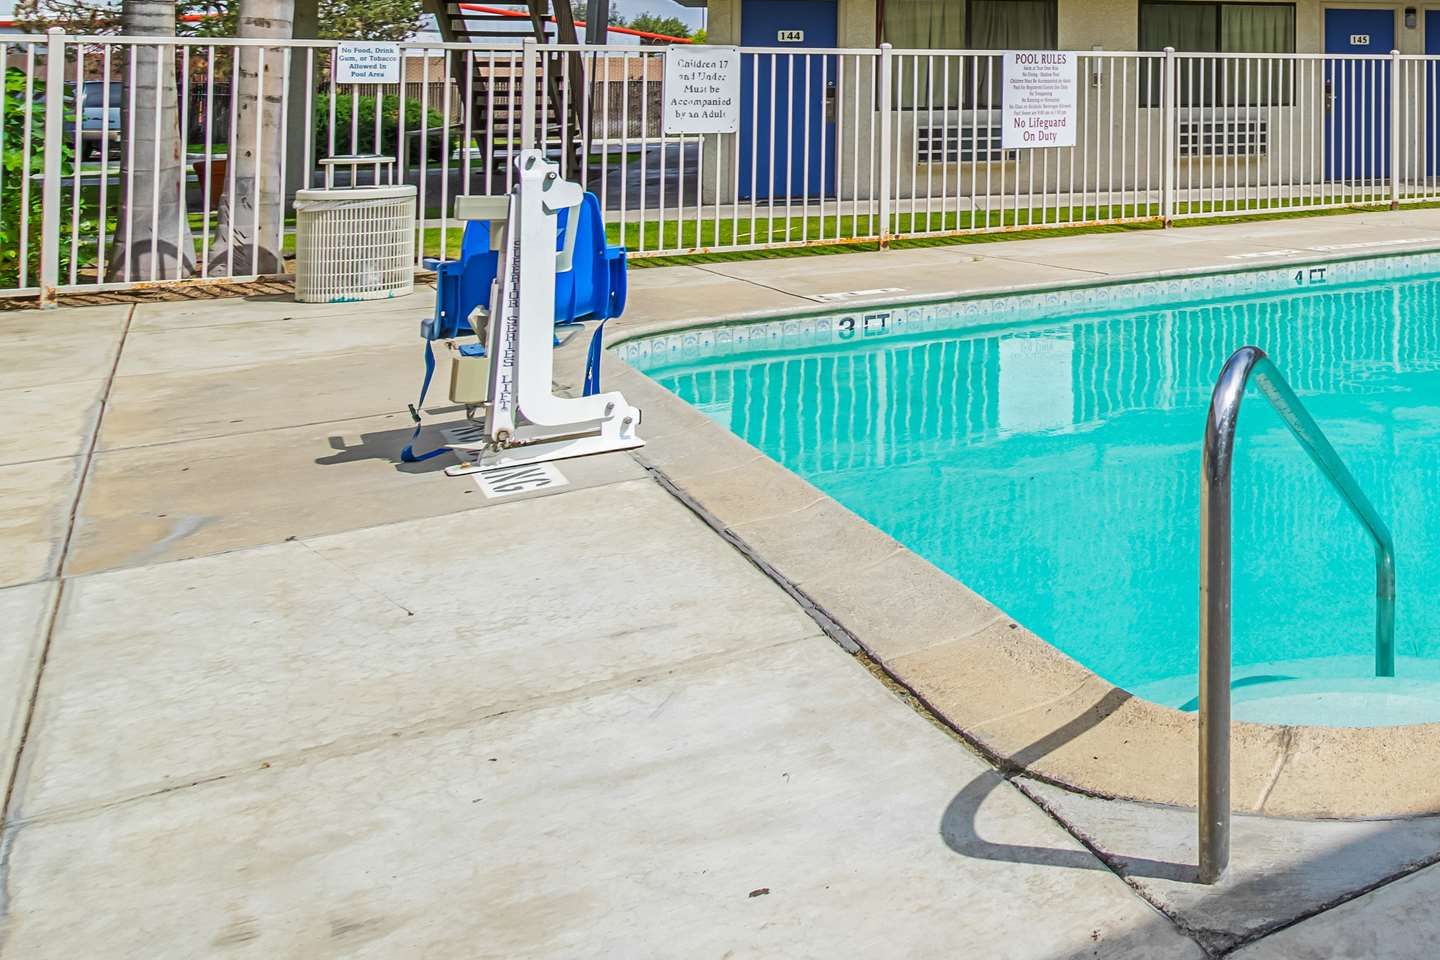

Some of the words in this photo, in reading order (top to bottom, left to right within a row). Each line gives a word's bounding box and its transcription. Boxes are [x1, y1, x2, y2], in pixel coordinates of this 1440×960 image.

[781, 31, 801, 41] 144
[1352, 36, 1368, 44] 145
[677, 59, 716, 69] Children
[719, 60, 729, 69] 17
[1015, 53, 1039, 65] POOL
[1041, 53, 1067, 65] RULES
[683, 84, 707, 93] Must
[709, 85, 720, 93] be
[671, 98, 732, 108] Accompanied
[675, 110, 686, 120] by
[702, 110, 726, 118] Adult
[1013, 117, 1026, 128] No
[1028, 117, 1066, 129] Lifeguard
[1023, 130, 1035, 141] On
[1038, 130, 1057, 142] Duty
[838, 316, 856, 335] 3
[864, 313, 890, 332] FT
